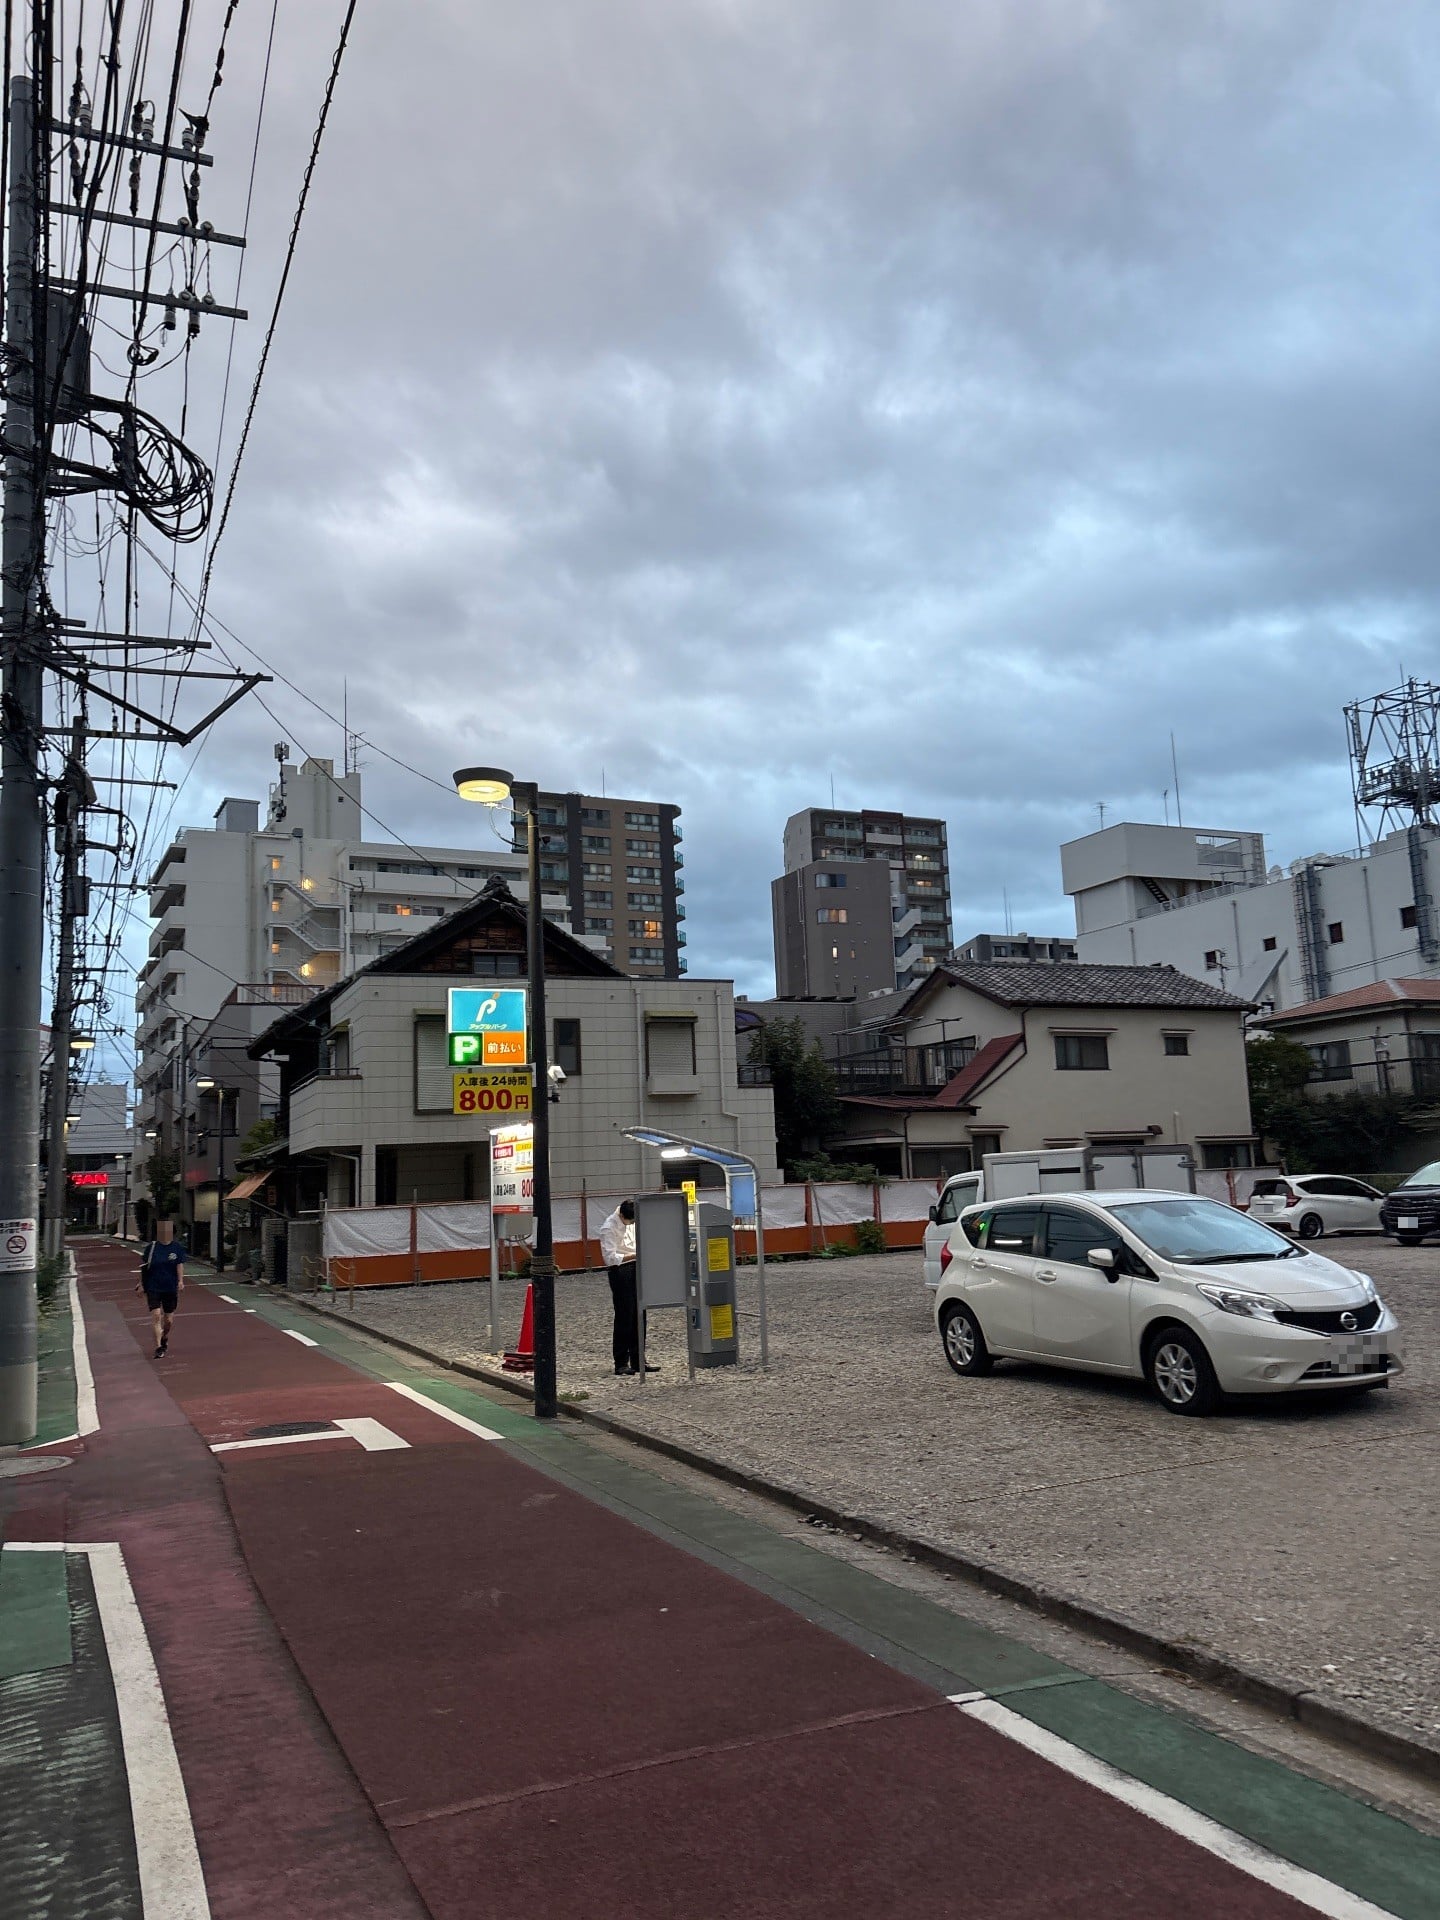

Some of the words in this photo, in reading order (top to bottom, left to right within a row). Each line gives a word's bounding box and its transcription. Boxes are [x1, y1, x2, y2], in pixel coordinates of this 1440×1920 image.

[454, 1035, 479, 1062] P
[487, 1042, 521, 1054] 前払い
[459, 1089, 529, 1111] 800円
